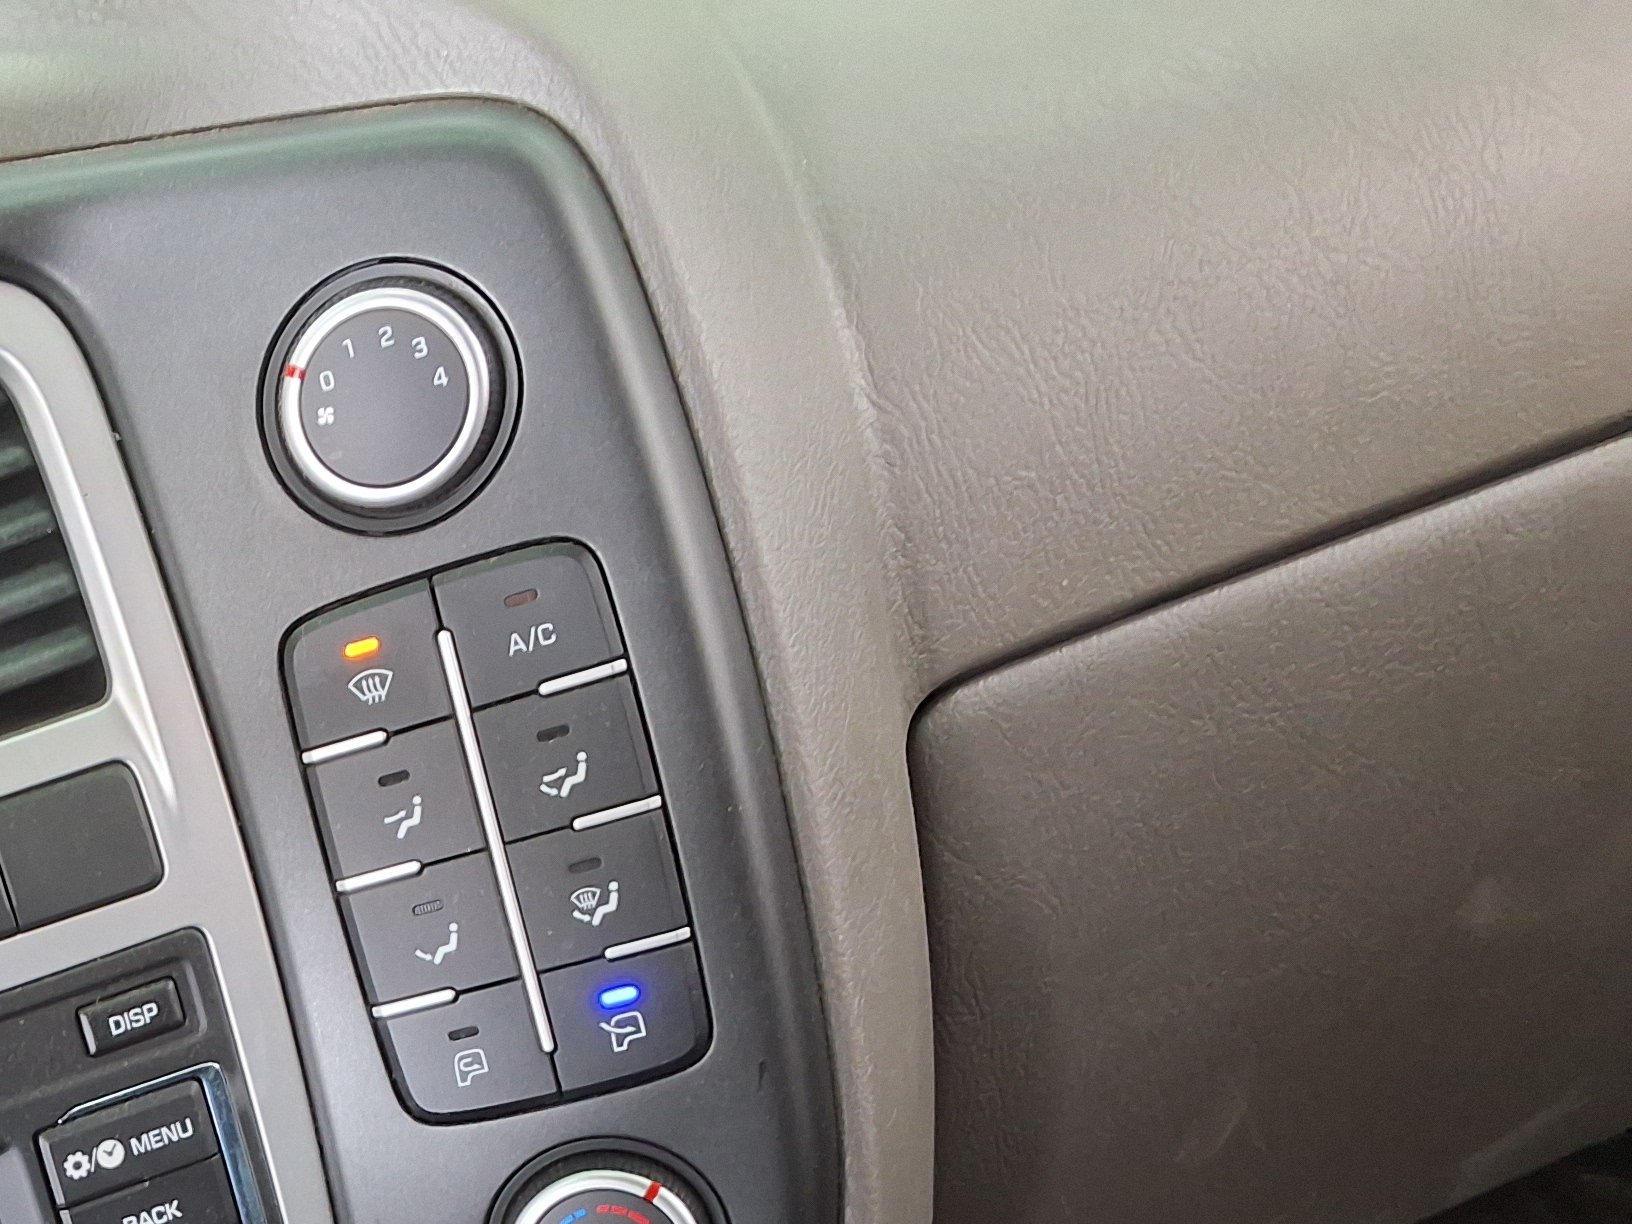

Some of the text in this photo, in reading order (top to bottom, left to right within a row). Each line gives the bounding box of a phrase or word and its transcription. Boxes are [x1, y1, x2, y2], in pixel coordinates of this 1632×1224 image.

[319, 325, 449, 392] 0 1 2 3 4
[508, 622, 557, 657] A/C
[108, 1001, 159, 1036] DISP
[130, 1117, 194, 1156] MENU
